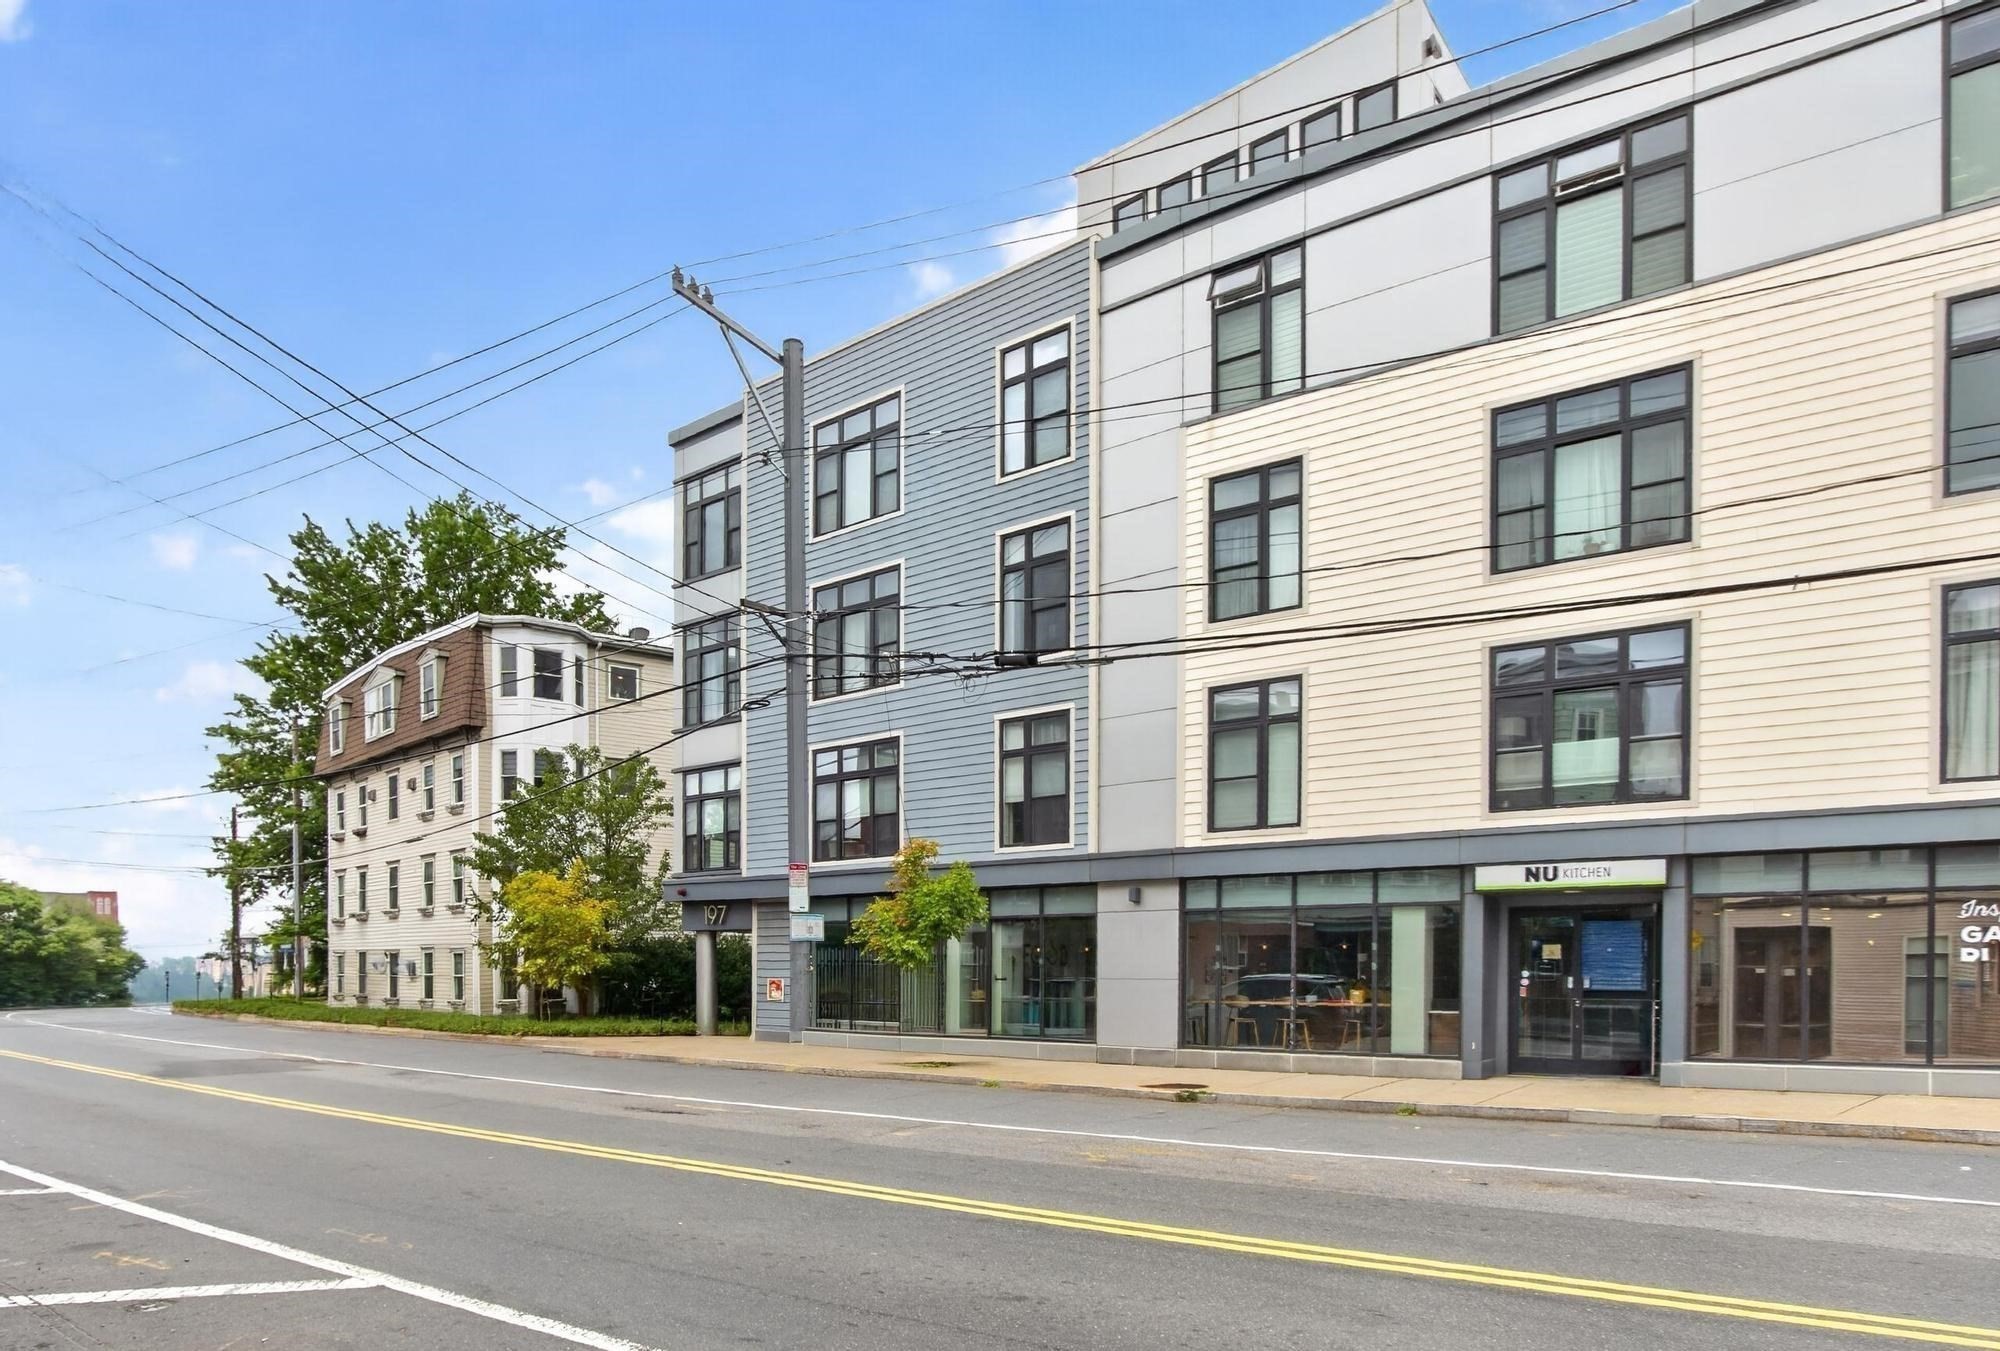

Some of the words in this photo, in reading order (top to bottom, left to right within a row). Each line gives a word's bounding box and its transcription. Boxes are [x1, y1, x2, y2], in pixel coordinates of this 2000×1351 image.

[1525, 866, 1558, 882] NU
[1562, 866, 1611, 878] KITCHEN
[704, 905, 726, 925] 197
[1957, 900, 2000, 923] Ins
[1960, 926, 2000, 943] GA
